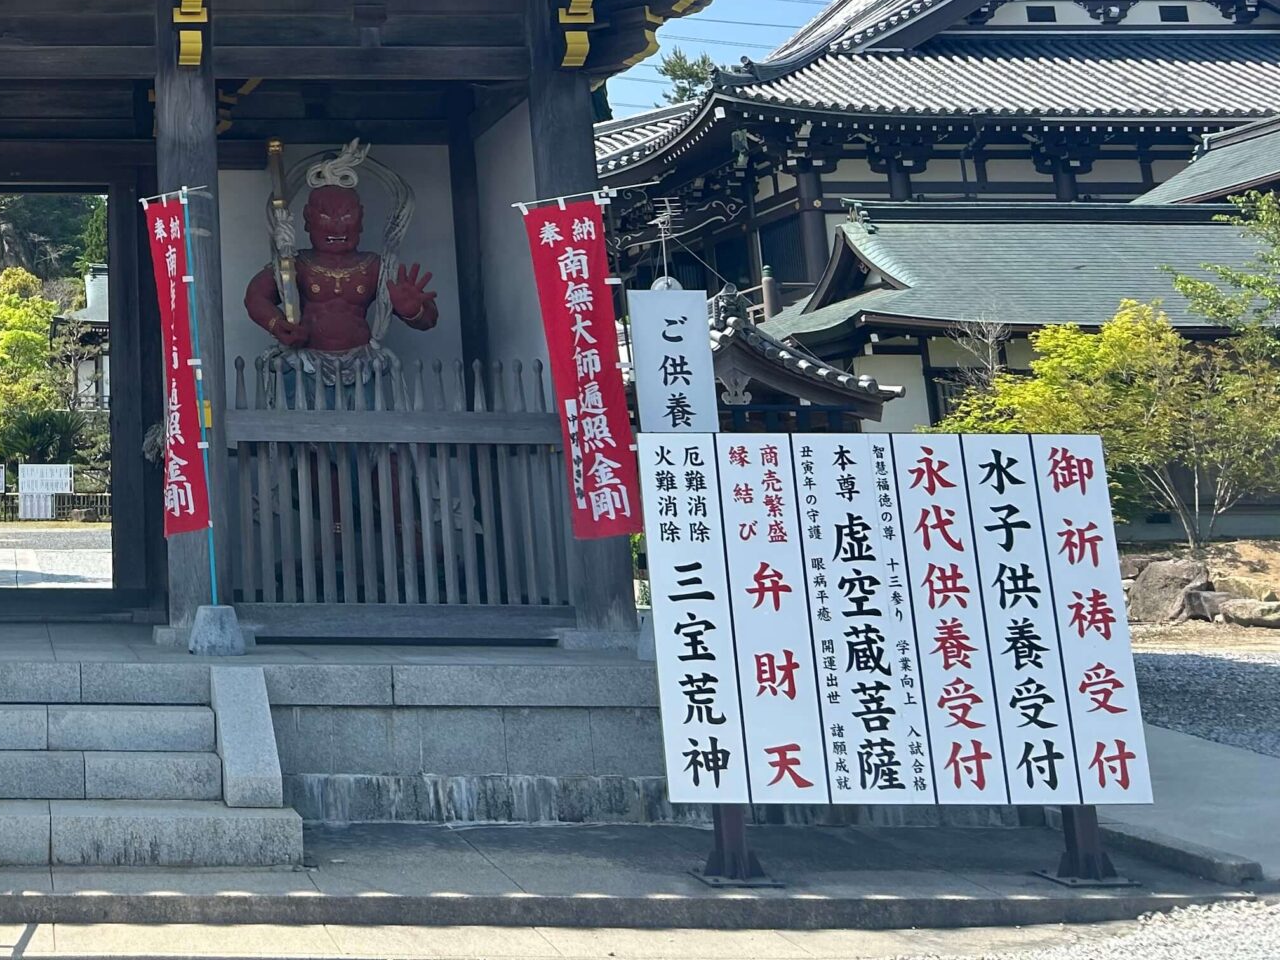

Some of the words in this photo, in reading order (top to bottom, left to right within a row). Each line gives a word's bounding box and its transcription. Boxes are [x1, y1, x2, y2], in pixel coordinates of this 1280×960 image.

[539, 217, 597, 248] 奉納
[557, 247, 631, 522] 南無大師遍照金剛
[658, 316, 697, 428] ご供養
[654, 445, 682, 543] 火難消除
[683, 446, 711, 543] 厄難消除
[728, 445, 758, 541] 縁結び
[759, 444, 788, 543] 商売繁盛
[668, 562, 731, 788] 三宝荒神
[745, 562, 814, 788] 弁財天
[821, 639, 841, 705] 開運出世
[832, 512, 906, 790] 虚空蔵菩薩
[908, 446, 993, 791] 永代供養受付
[979, 449, 1065, 791] 水子供養受付
[1047, 447, 1136, 791] 御祈祷受付
[830, 723, 852, 790] 諸願成就
[896, 640, 917, 706] 学業向上
[907, 725, 927, 792] 入試合格
